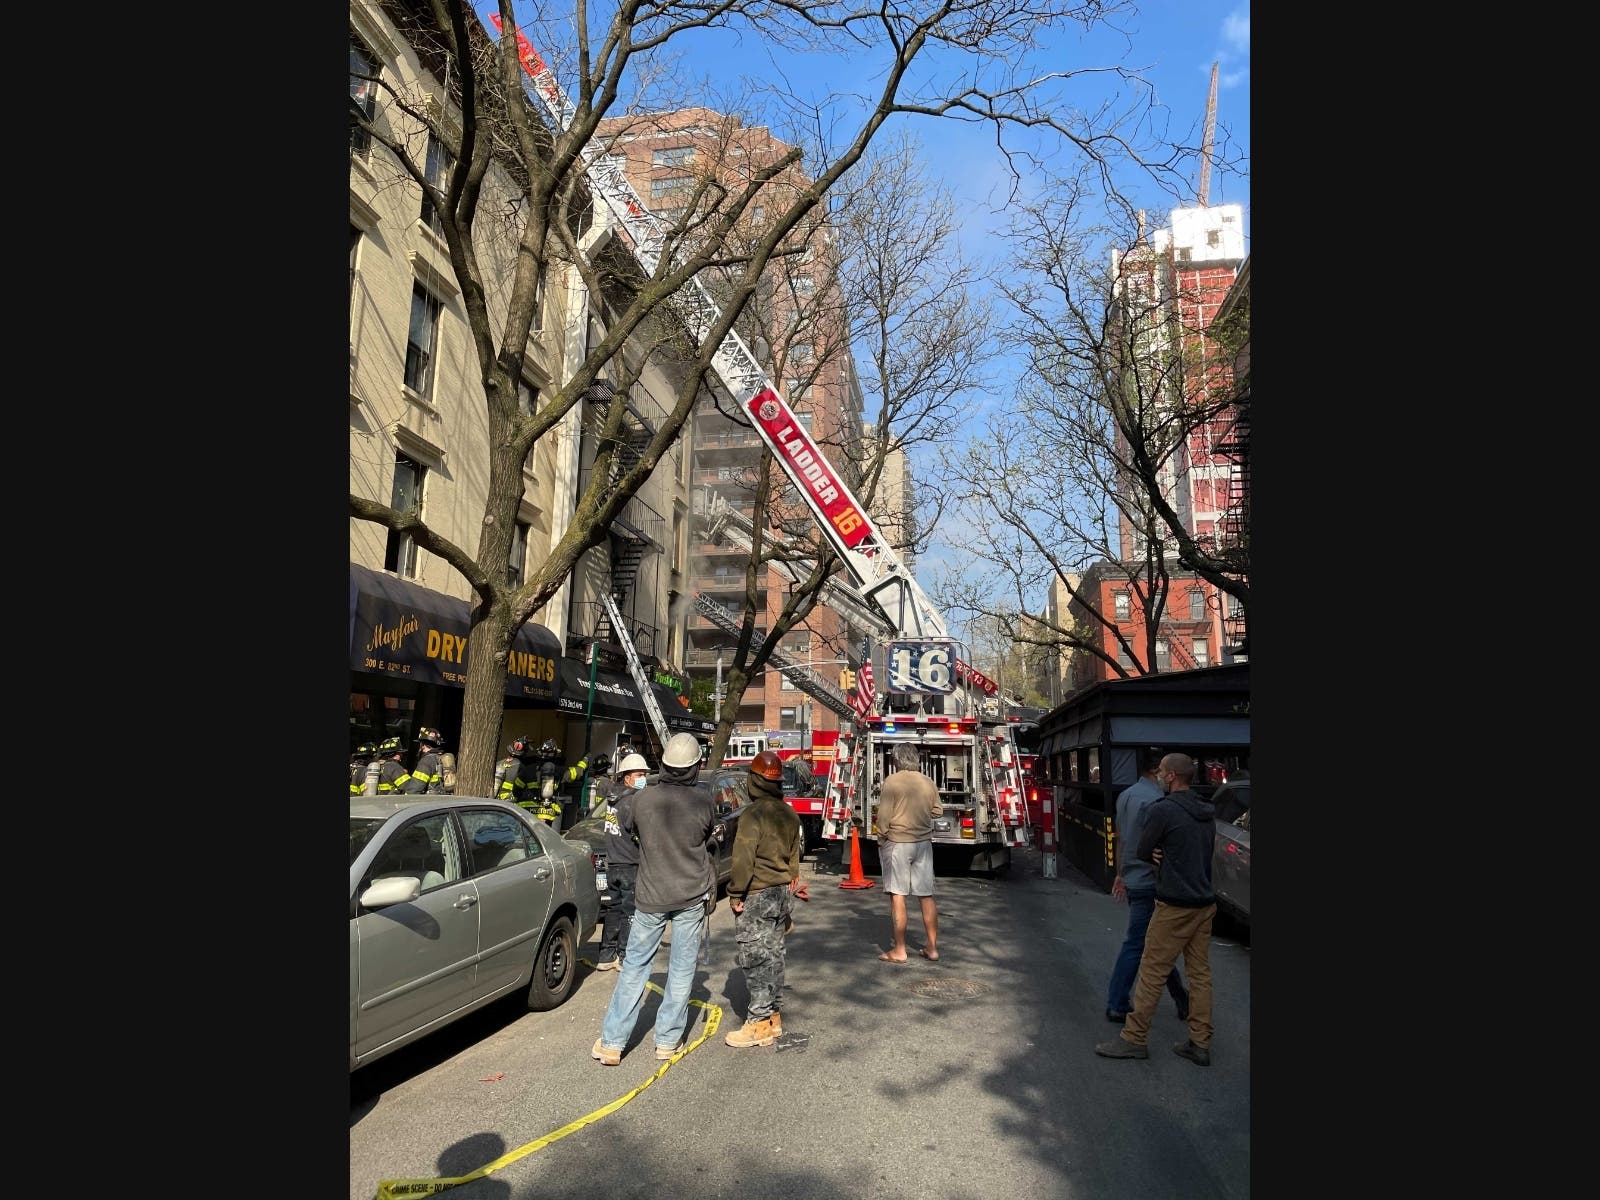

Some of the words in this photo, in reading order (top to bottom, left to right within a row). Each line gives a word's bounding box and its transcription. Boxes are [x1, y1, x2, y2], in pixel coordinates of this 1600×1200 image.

[777, 426, 838, 505] LADDER
[833, 507, 863, 536] 16
[366, 614, 420, 651] Mayfair
[364, 658, 377, 668] 300
[378, 660, 384, 670] E
[427, 629, 468, 664] DRY
[507, 650, 555, 682] ANERS
[892, 649, 950, 687] 16
[442, 671, 456, 682] FREE
[411, 1183, 429, 1193] SCENE
